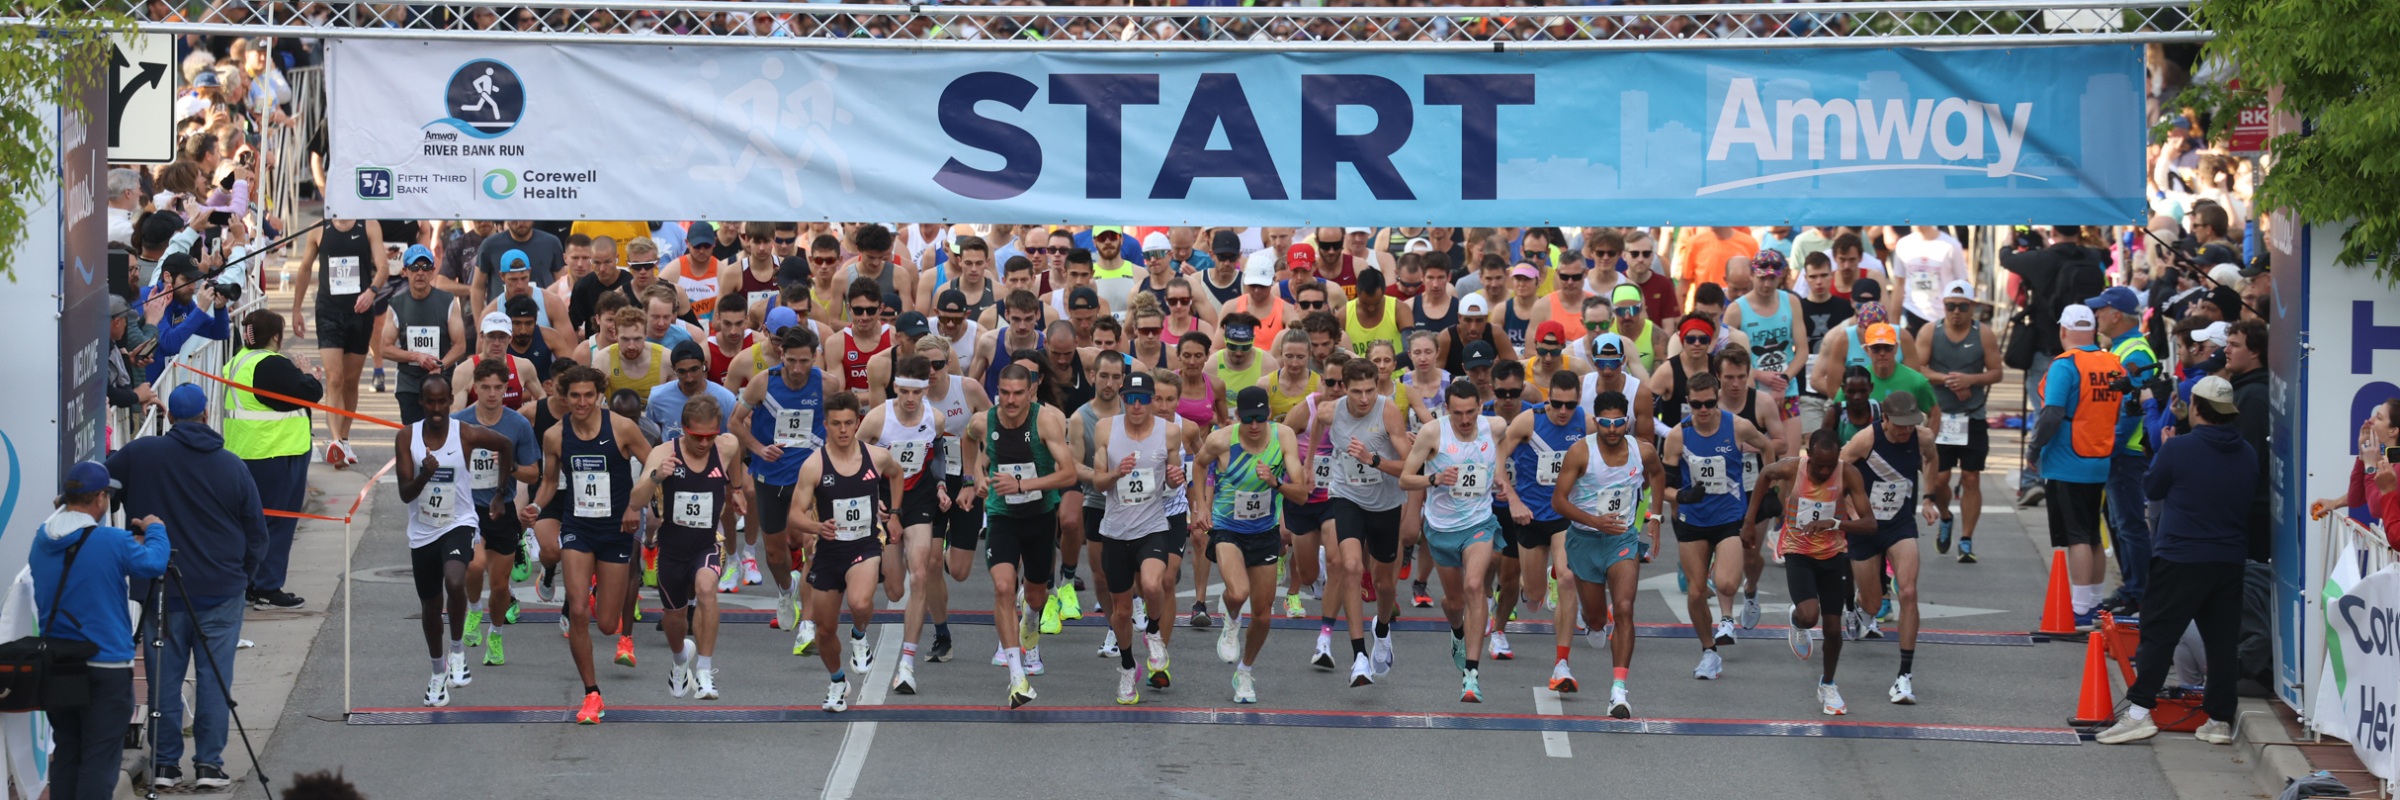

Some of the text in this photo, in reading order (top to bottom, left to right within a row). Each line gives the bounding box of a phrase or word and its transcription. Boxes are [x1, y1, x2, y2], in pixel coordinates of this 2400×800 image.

[1706, 78, 2033, 178] Amway
[425, 130, 458, 142] Amway
[932, 71, 1536, 201] START
[423, 144, 525, 156] RIVER BANK RUN
[523, 169, 597, 183] Corewell
[523, 186, 578, 199] Health
[1293, 251, 1308, 260] USA
[336, 266, 352, 278] 517
[413, 336, 434, 348] 1801
[73, 338, 99, 390] WELCOME
[801, 398, 818, 406] GRC
[947, 407, 963, 417] DWR
[789, 418, 800, 428] 13
[1565, 434, 1582, 442] GRC
[1715, 445, 1732, 454] GRC
[900, 451, 914, 463] 62
[473, 459, 495, 471] 1817
[1315, 465, 1330, 477] 43
[1356, 463, 1365, 474] 2
[1551, 461, 1562, 474] 16
[1700, 466, 1714, 477] 20
[1129, 480, 1144, 493] 23
[1462, 474, 1476, 487] 26
[585, 483, 597, 496] 41
[429, 496, 443, 508] 47
[1882, 492, 1896, 502] 32
[686, 503, 700, 516] 53
[1246, 500, 1260, 511] 54
[1608, 498, 1621, 512] 39
[846, 509, 860, 521] 60
[1812, 510, 1820, 522] 9
[2338, 594, 2400, 657] Cor
